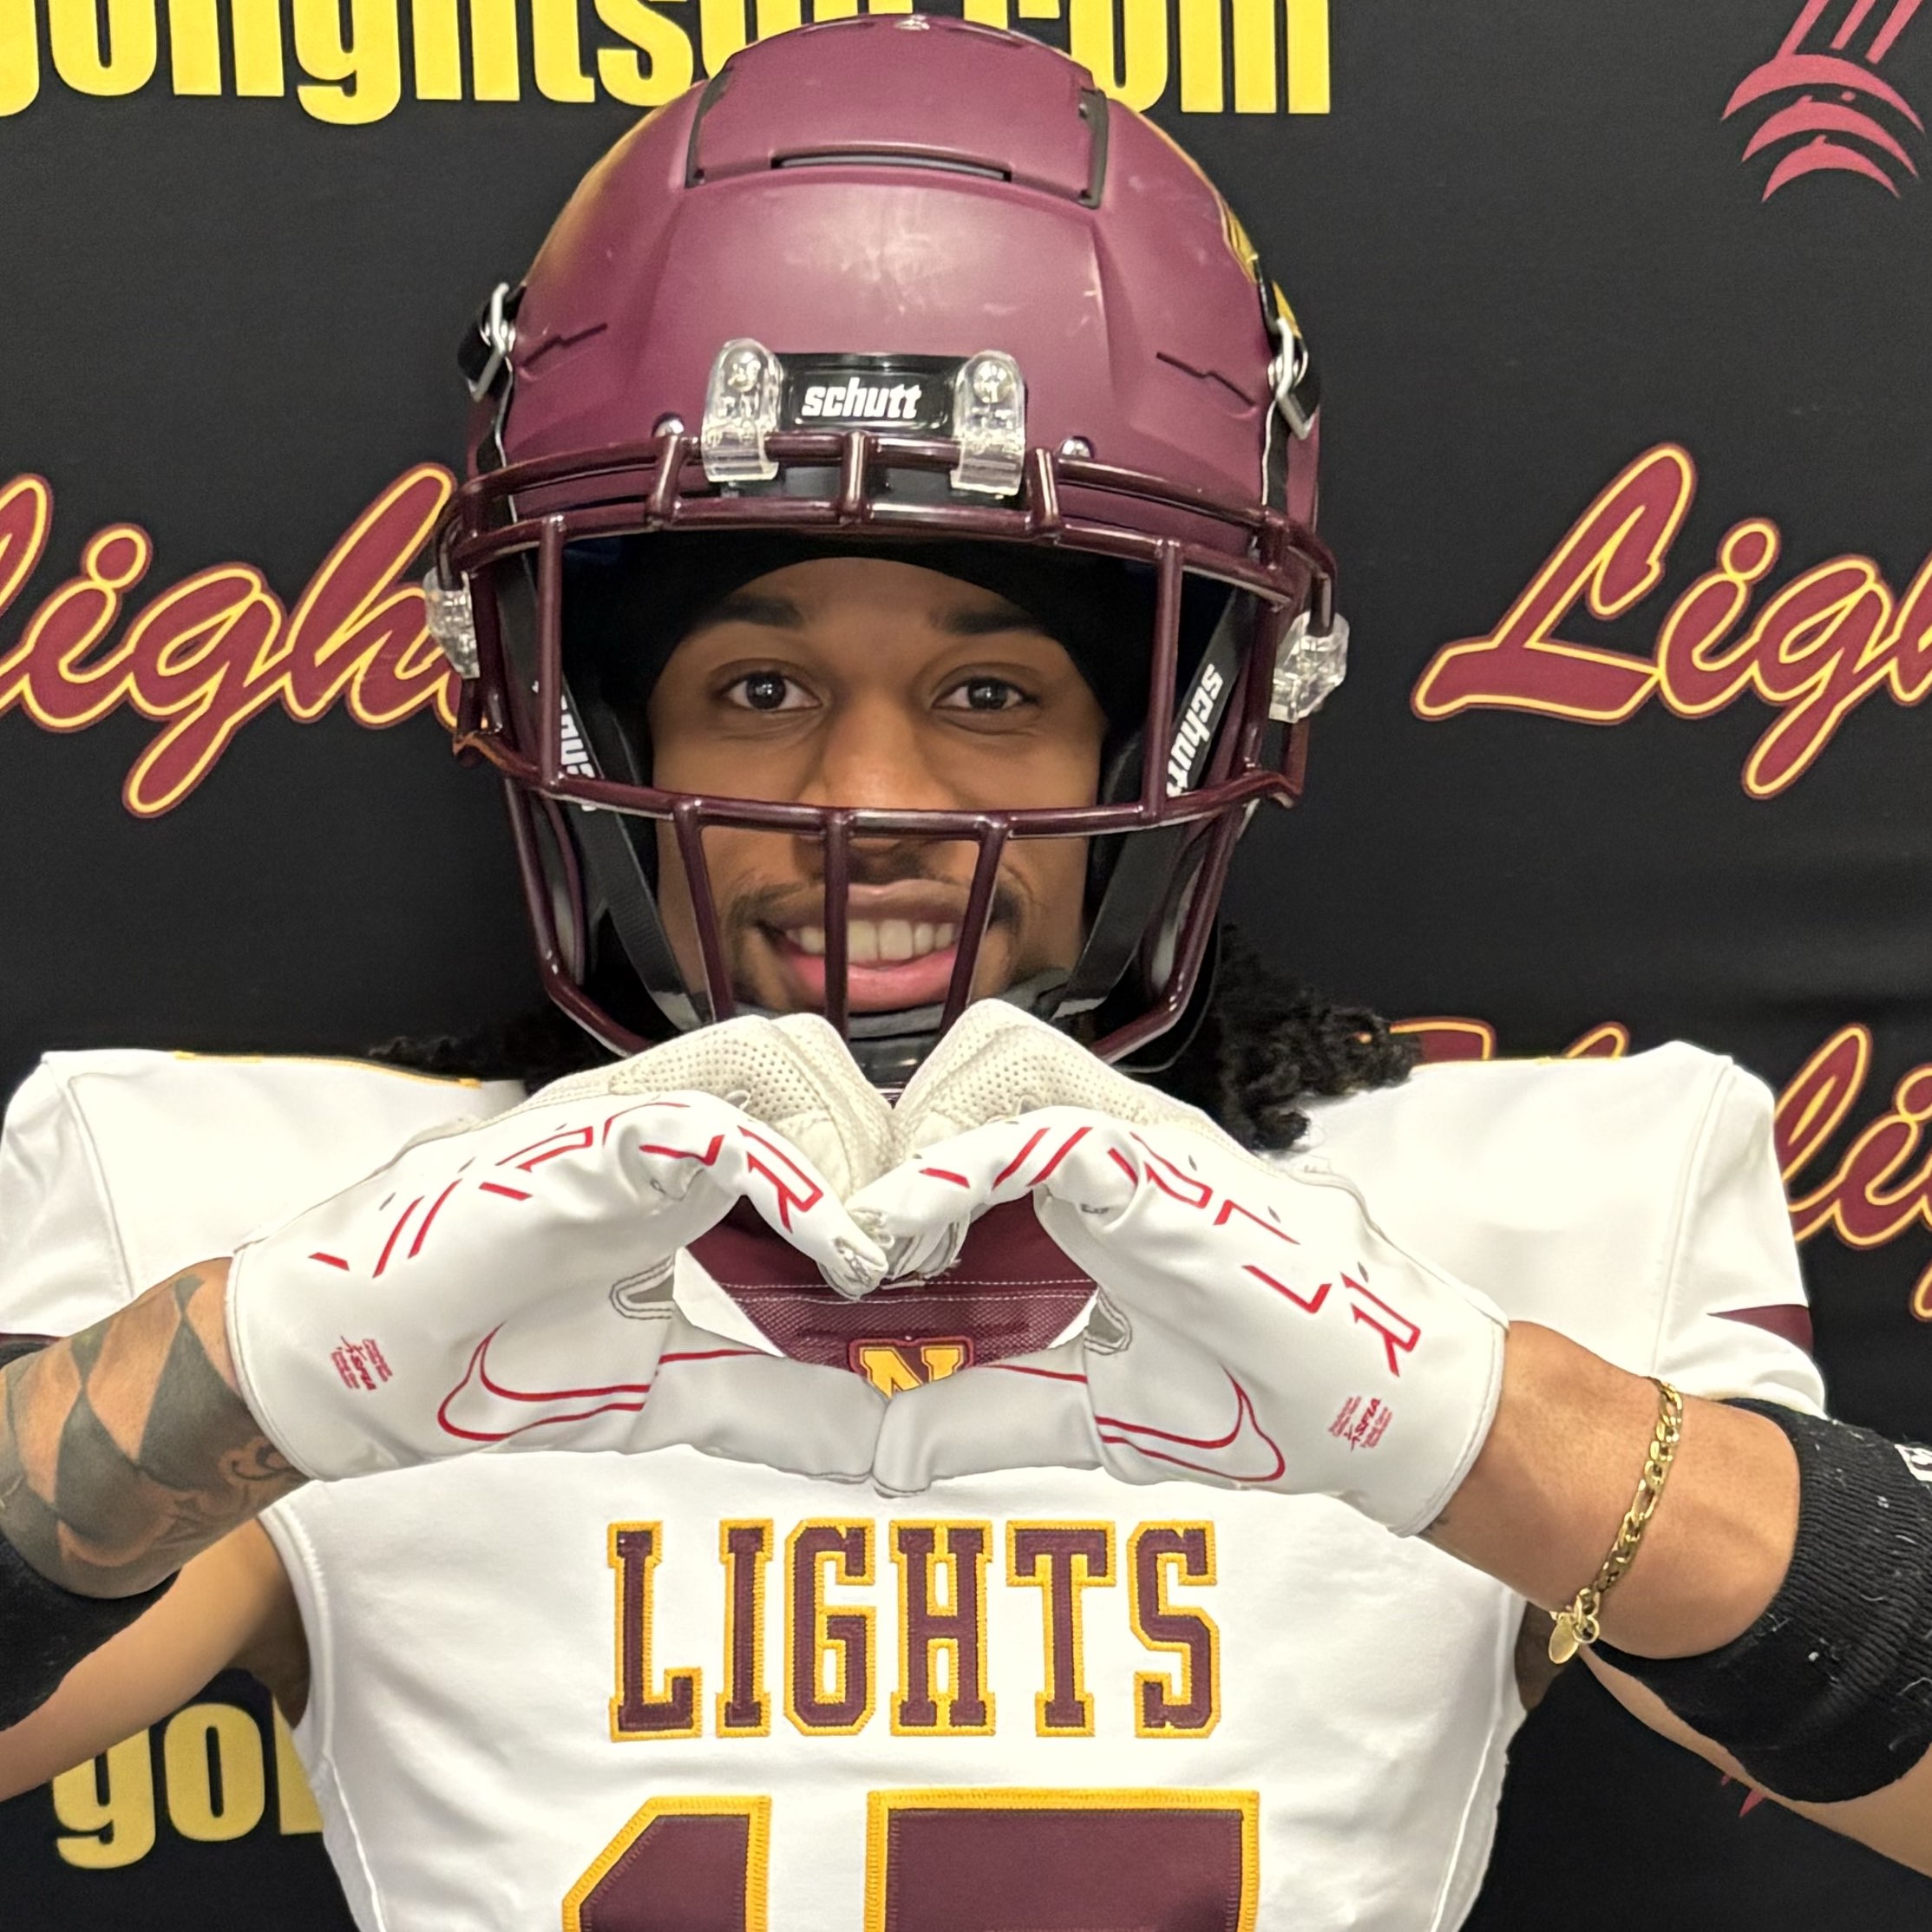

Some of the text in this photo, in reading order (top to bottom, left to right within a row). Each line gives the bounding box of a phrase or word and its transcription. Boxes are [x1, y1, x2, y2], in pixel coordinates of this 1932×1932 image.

[801, 376, 922, 419] schutt
[1411, 442, 1932, 800] Lig
[607, 1517, 1220, 1741] LIGHTS
